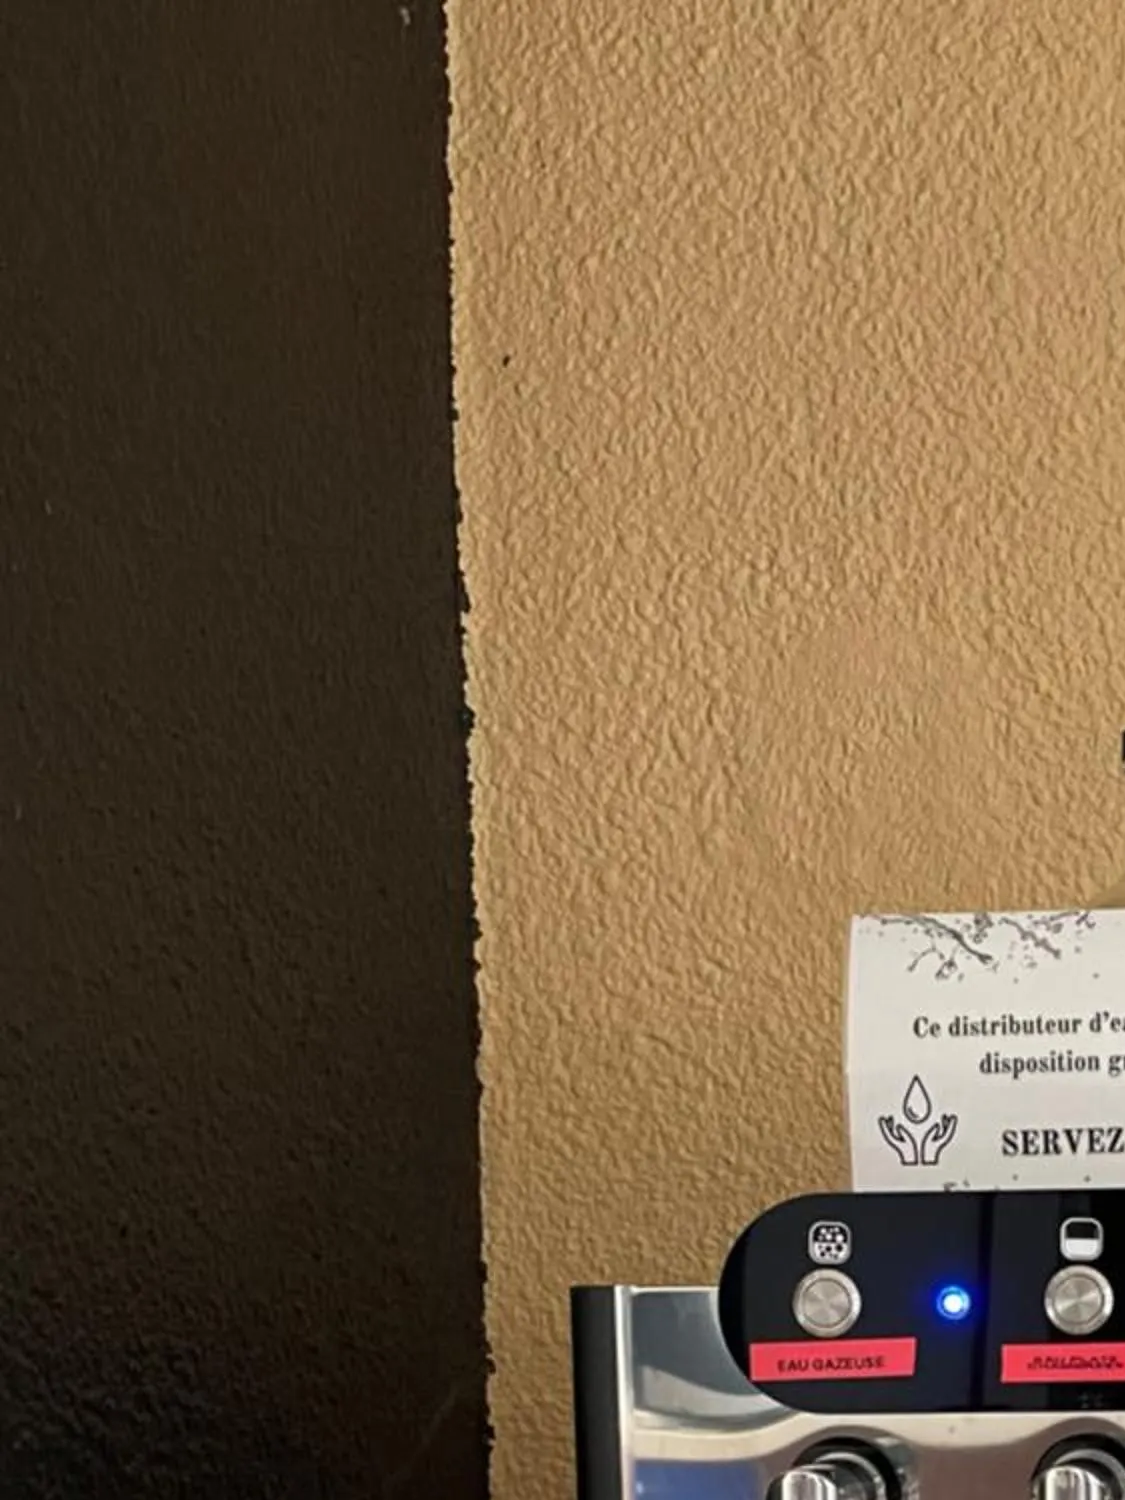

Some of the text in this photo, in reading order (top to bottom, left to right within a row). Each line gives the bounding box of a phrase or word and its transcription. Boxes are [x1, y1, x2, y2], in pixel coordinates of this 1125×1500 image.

[912, 1016, 941, 1038] Ce
[948, 1013, 1081, 1037] distributeur
[979, 1049, 1100, 1080] disposition
[1001, 1126, 1125, 1156] SERVEZ
[777, 1356, 885, 1373] EAU GAZEUSE
